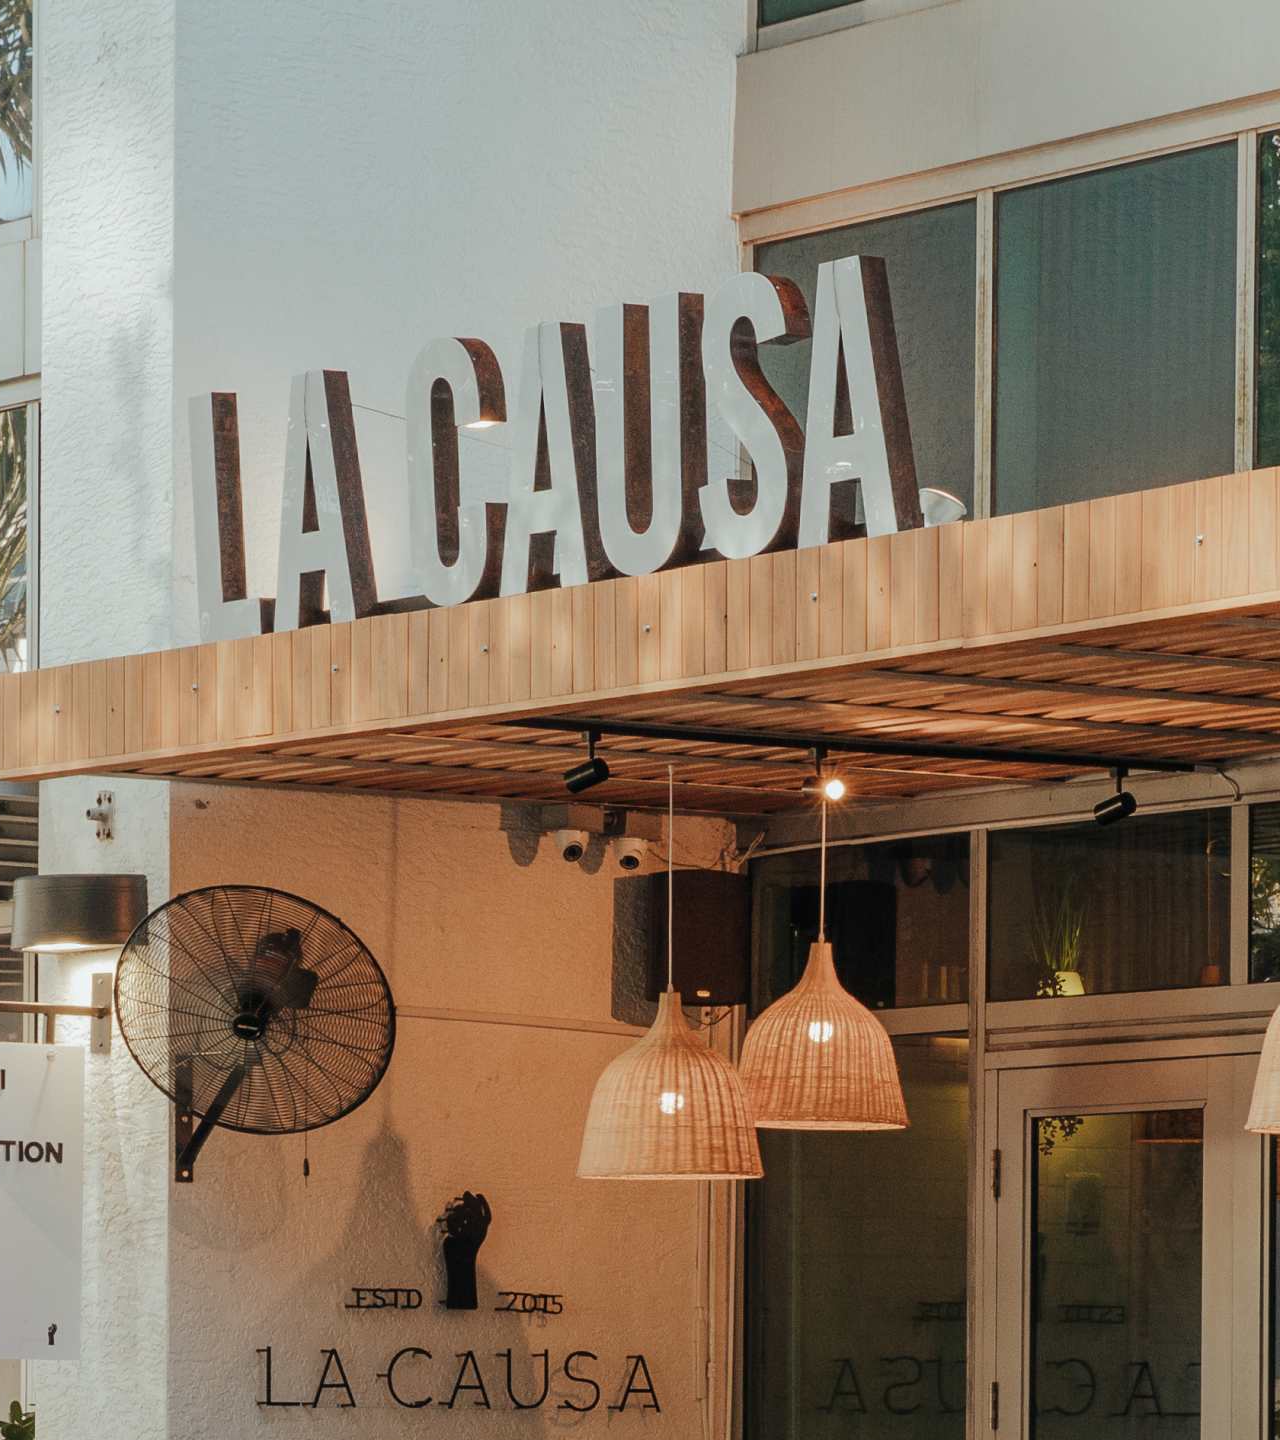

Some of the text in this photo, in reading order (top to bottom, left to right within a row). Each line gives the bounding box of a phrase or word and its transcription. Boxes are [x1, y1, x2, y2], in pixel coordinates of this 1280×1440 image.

[188, 254, 922, 635] LA CAUSA
[350, 1288, 564, 1314] ESTD 2015
[262, 1346, 662, 1413] LA CAUSA
